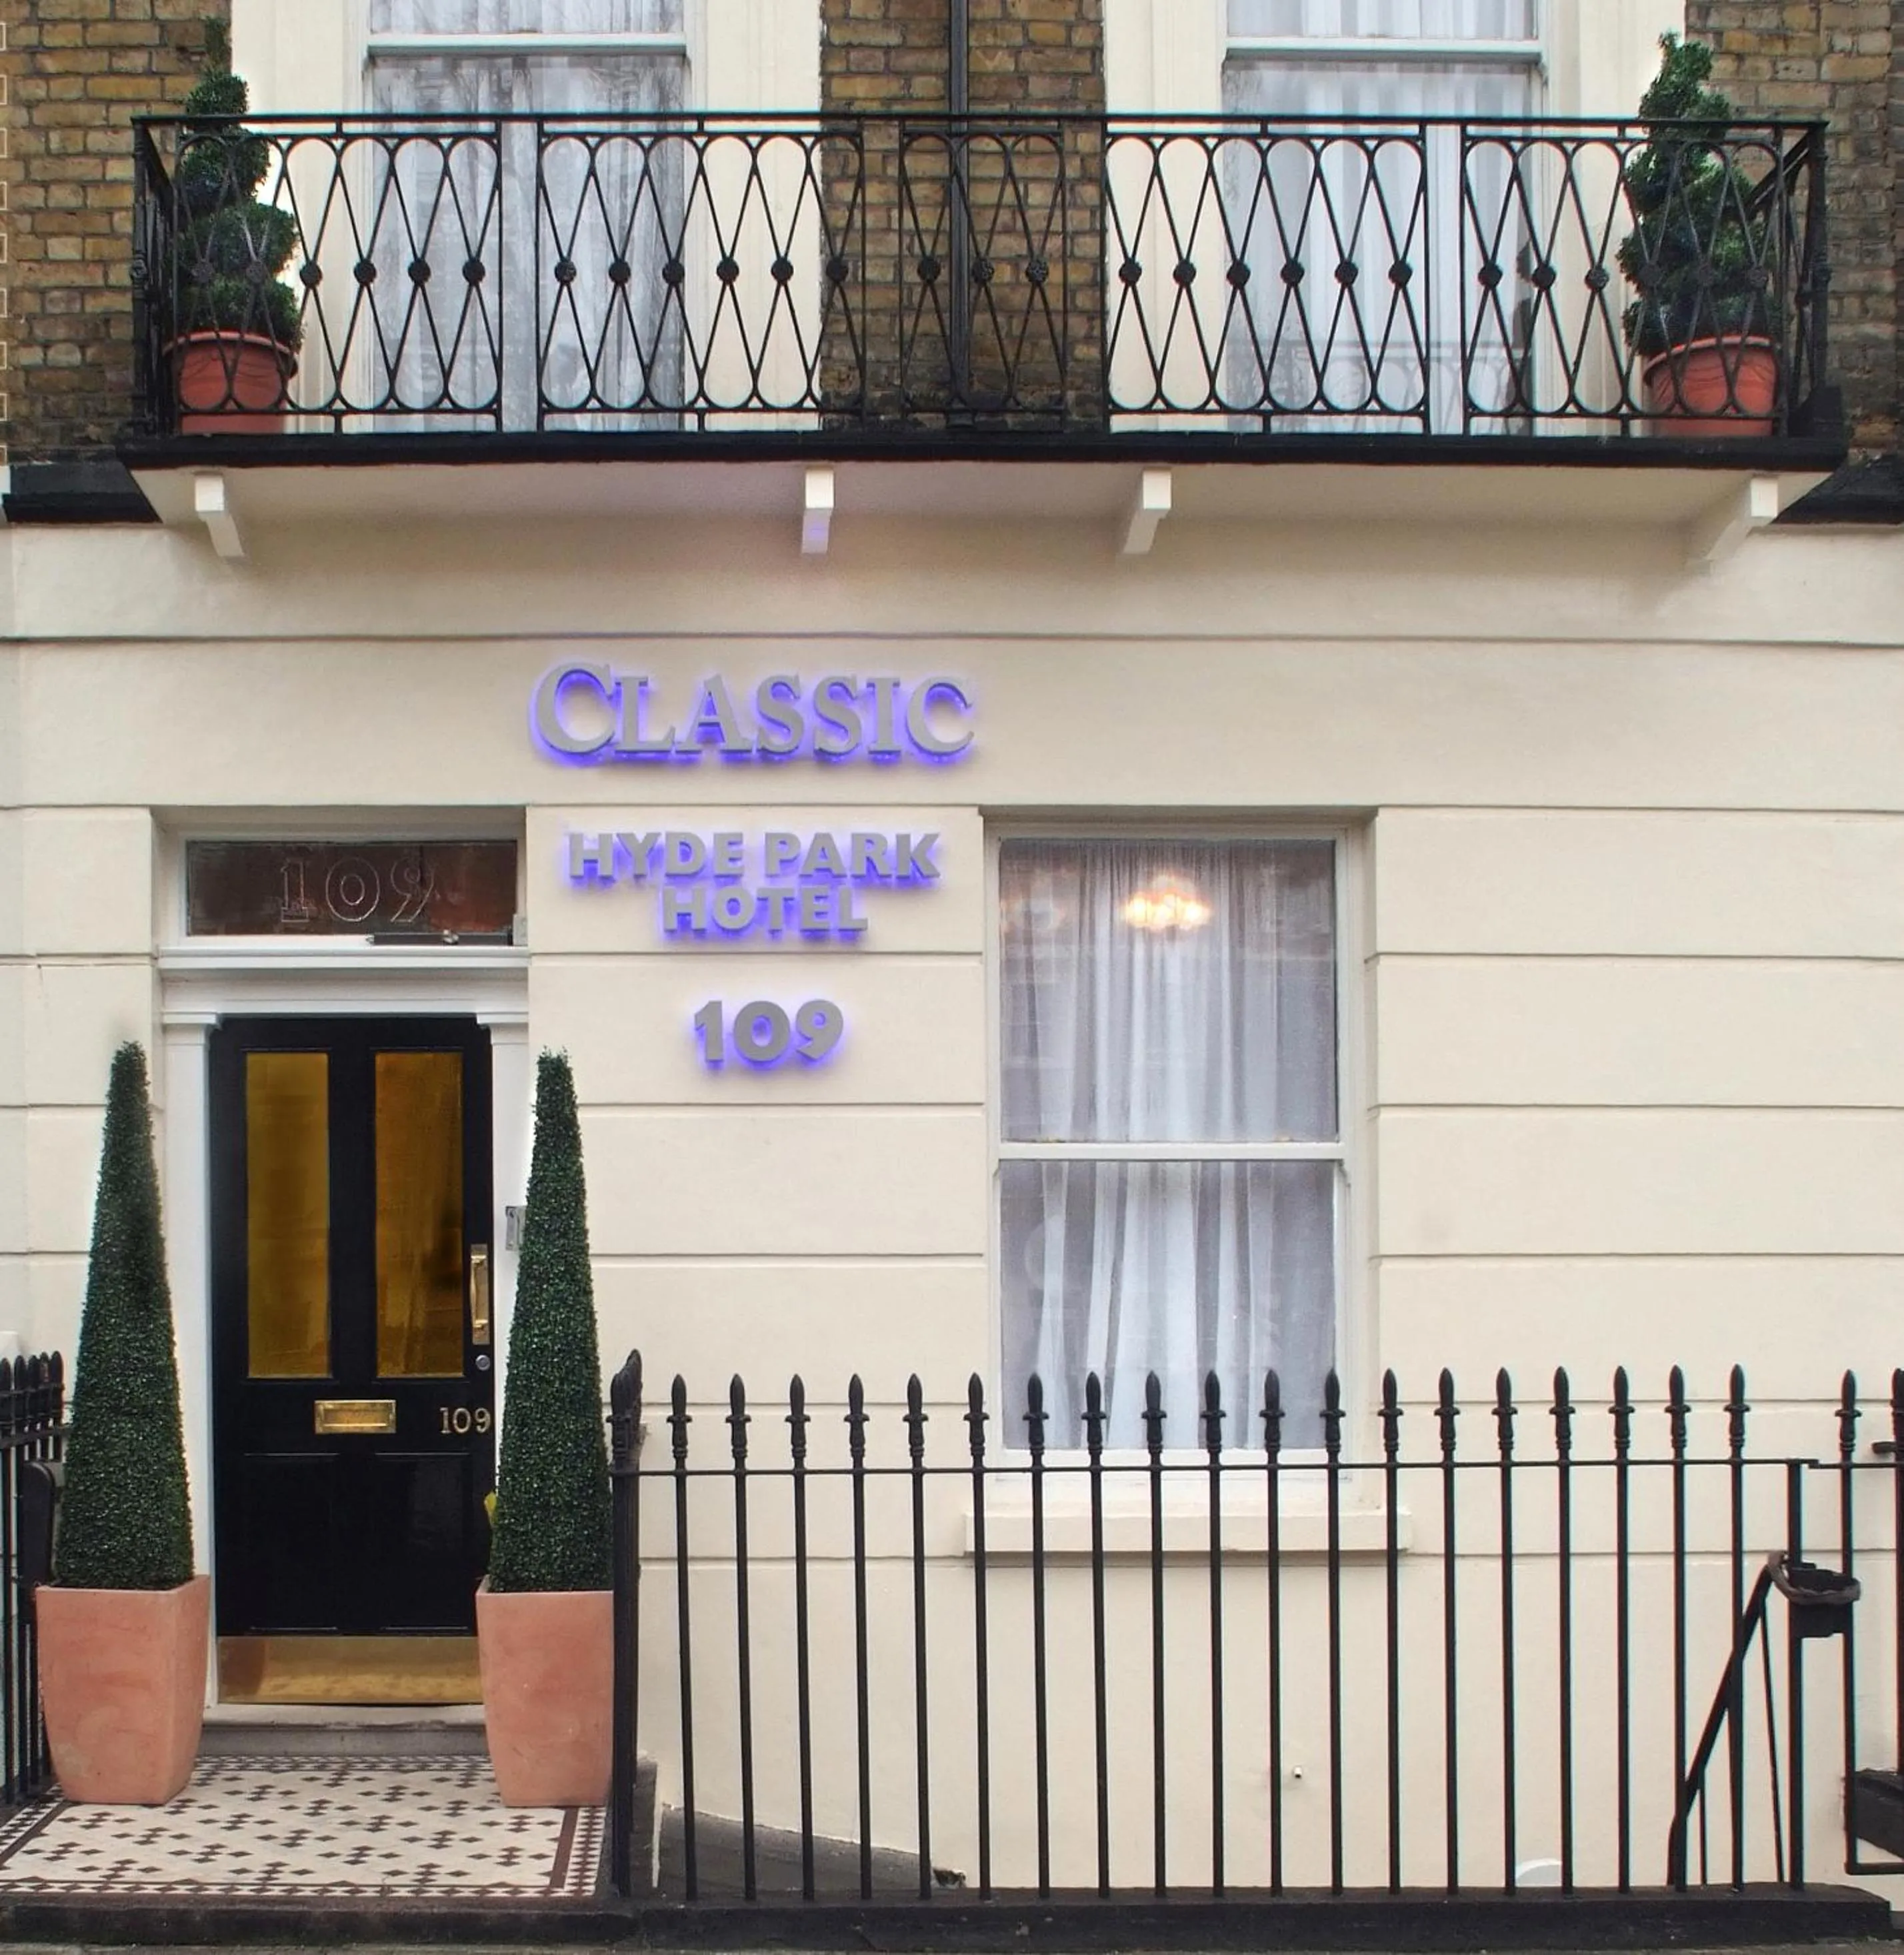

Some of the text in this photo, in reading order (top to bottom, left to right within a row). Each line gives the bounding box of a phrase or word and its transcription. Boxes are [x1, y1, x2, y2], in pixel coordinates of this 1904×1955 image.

[535, 662, 975, 757] CLASSIC
[569, 832, 941, 879] HYDE PARK
[281, 855, 435, 923] 109
[663, 885, 869, 933] HOTEL
[693, 999, 845, 1064] 109
[439, 1407, 491, 1434] 109
